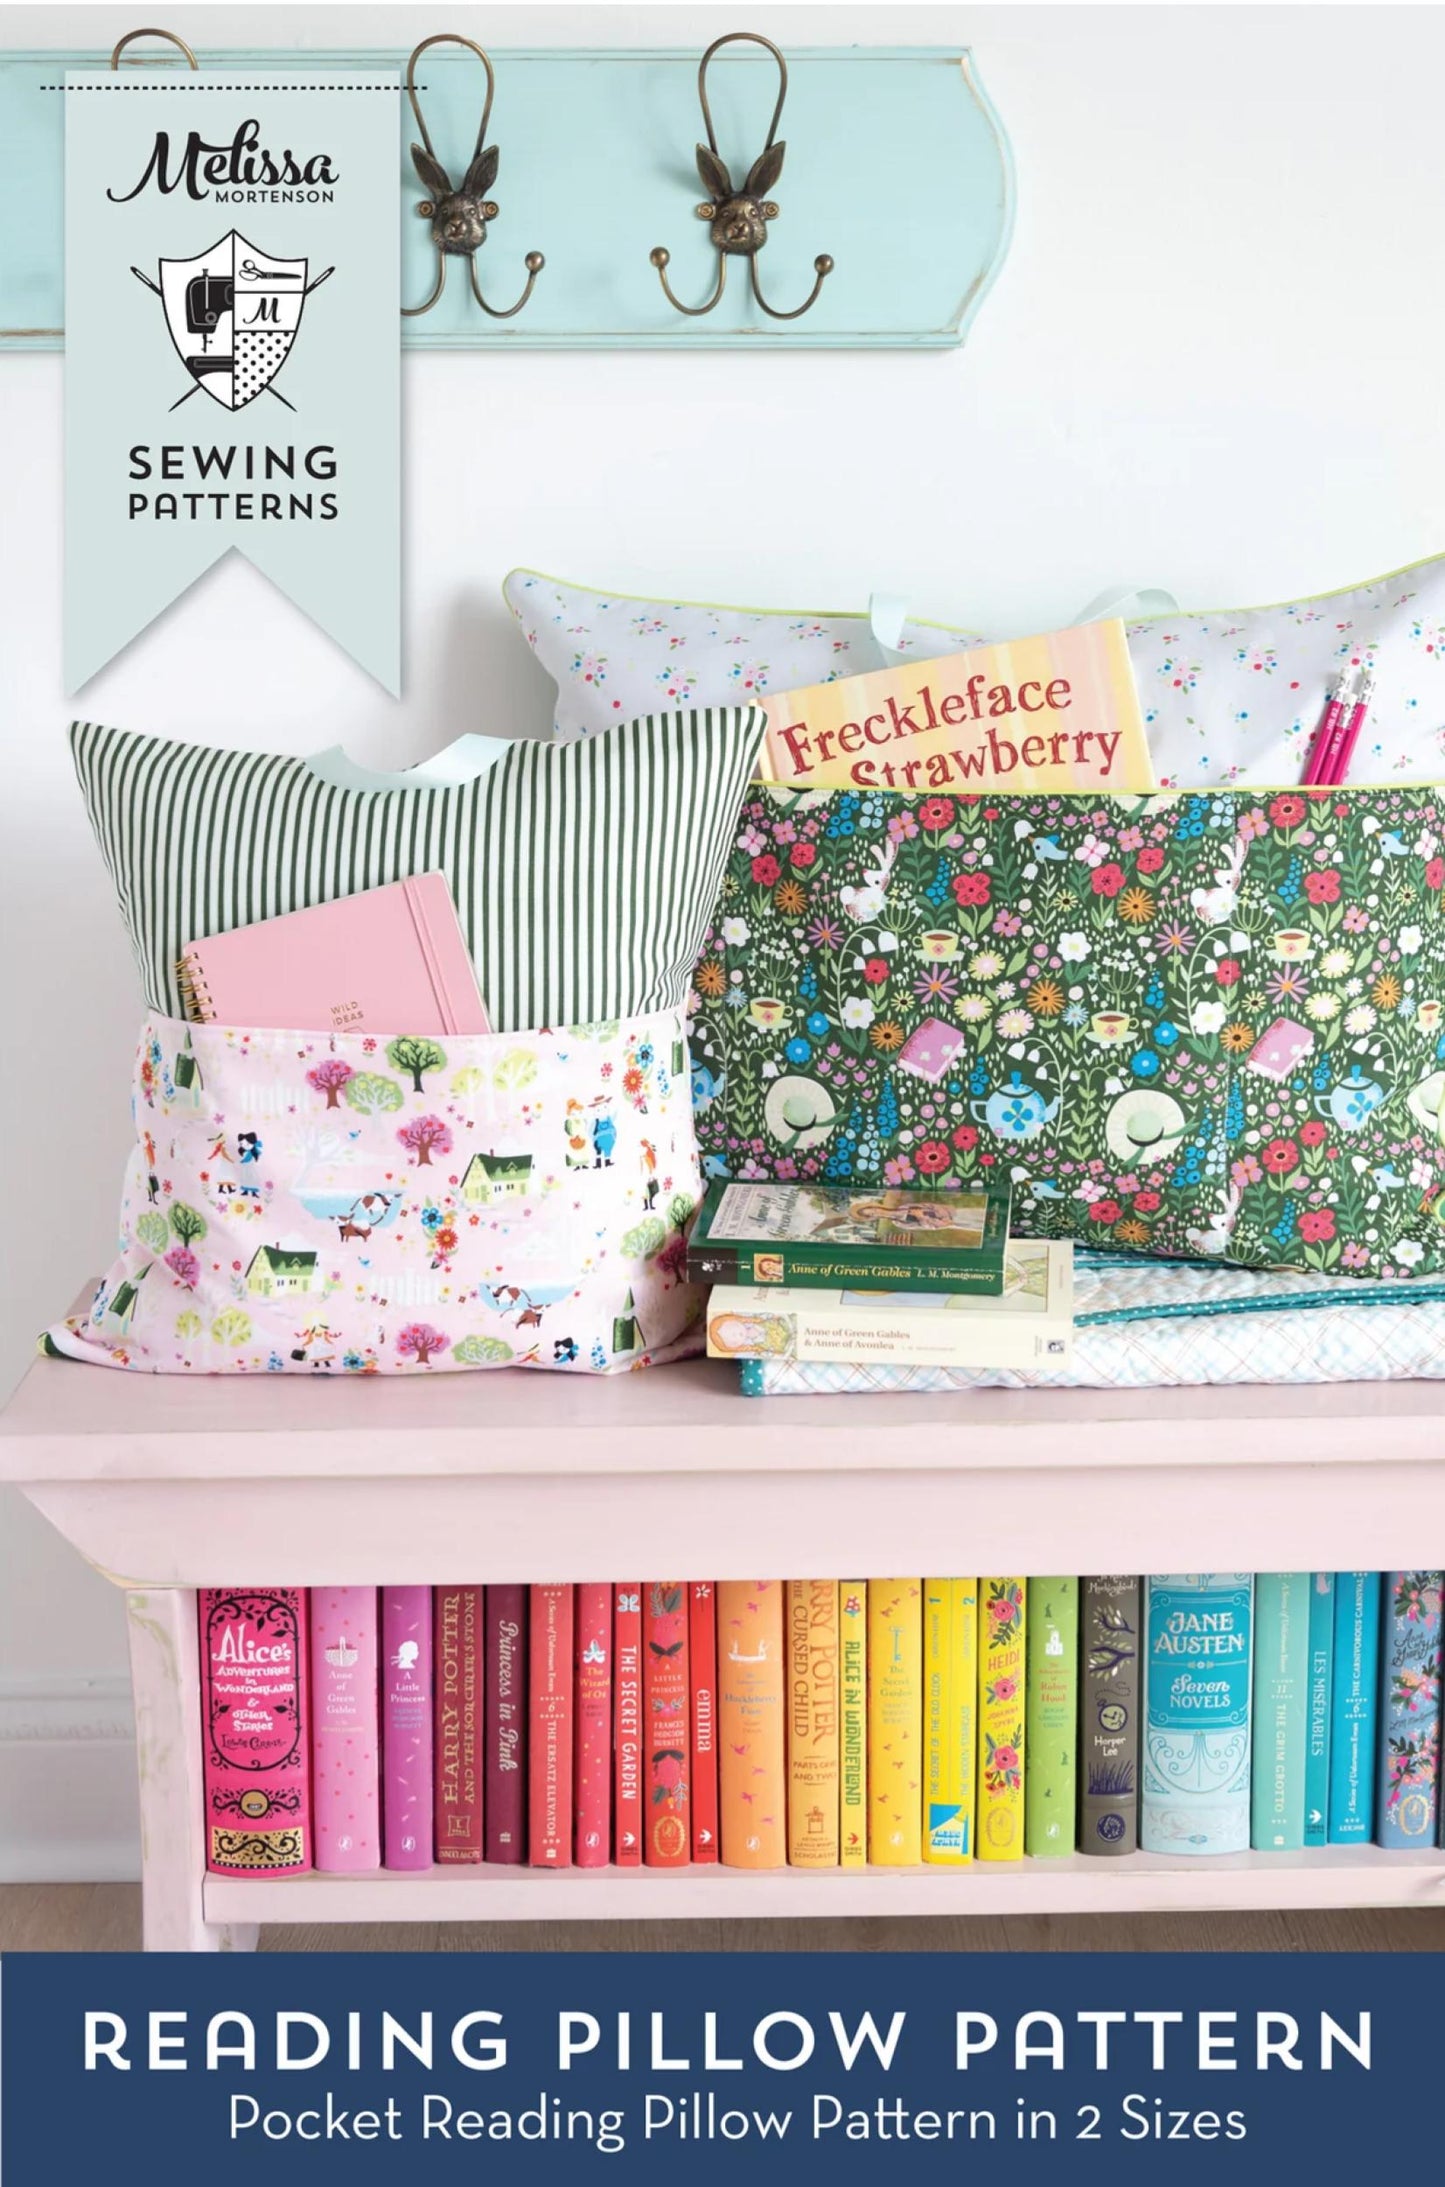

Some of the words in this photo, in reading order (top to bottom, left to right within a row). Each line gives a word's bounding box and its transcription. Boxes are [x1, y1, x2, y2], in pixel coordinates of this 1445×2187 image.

[777, 674, 1072, 776] Freckleface
[850, 728, 1123, 787] Strawberry
[330, 1001, 358, 1015] WILD
[332, 1011, 364, 1026] IDEAS
[788, 1263, 818, 1274] Anne
[820, 1263, 832, 1276] of
[834, 1264, 869, 1276] Green
[871, 1266, 912, 1278] Gables
[917, 1269, 926, 1278] L.
[928, 1269, 939, 1279] M.
[941, 1270, 996, 1282] Montgomery
[804, 1327, 830, 1337] Anne
[832, 1328, 843, 1337] of
[844, 1329, 875, 1338] Green
[876, 1329, 911, 1339] Gables
[804, 1339, 812, 1347] &
[814, 1339, 840, 1348] Anne
[842, 1340, 852, 1348] of
[854, 1340, 895, 1350] Avonlea
[810, 1580, 835, 1634] RRY
[963, 1597, 975, 1605] 2
[1355, 1577, 1364, 1618] CARNIVAL
[464, 1592, 475, 1643] STONE
[1168, 1611, 1234, 1634] JANE
[211, 1622, 292, 1664] Alice's
[442, 1593, 459, 1695] POTTER
[792, 1605, 808, 1675] CURSED
[1154, 1632, 1245, 1655] AUSTEN
[1353, 1619, 1362, 1679] CARNIVOROUS
[499, 1619, 519, 1698] Princess
[621, 1645, 637, 1673] THE
[987, 1649, 1019, 1671] HEIDI
[1313, 1651, 1327, 1674] LES
[329, 1671, 353, 1680] Anne
[404, 1671, 411, 1680] A
[586, 1667, 603, 1676] The
[336, 1681, 346, 1691] of
[396, 1682, 420, 1692] Little
[464, 1645, 475, 1732] SORCERER'S
[582, 1690, 591, 1699] of
[810, 1643, 836, 1746] POTTER
[1171, 1673, 1230, 1694] Seven
[1352, 1680, 1360, 1697] THE
[247, 1697, 259, 1708] &
[326, 1705, 356, 1714] Gables
[327, 1693, 355, 1703] Green
[390, 1694, 426, 1703] Princess
[621, 1681, 637, 1736] SECRET
[794, 1680, 809, 1737] CHILD
[1170, 1694, 1231, 1708] NOVELS
[499, 1702, 516, 1721] in
[696, 1688, 711, 1753] emma
[1276, 1704, 1286, 1727] THE
[547, 1720, 556, 1740] THE
[931, 1719, 940, 1732] THE
[442, 1701, 459, 1804] HARRY
[464, 1733, 475, 1766] THE
[499, 1727, 519, 1772] Pink
[1094, 1735, 1127, 1748] Harper
[1103, 1746, 1118, 1756] Lee
[1276, 1730, 1286, 1761] GRIM
[547, 1744, 556, 1782] ERSATZ
[621, 1742, 637, 1799] GARDEN
[464, 1768, 475, 1805] AND
[793, 1773, 813, 1781] AND
[1274, 1764, 1285, 1813] GROTTO
[930, 1783, 939, 1795] THE
[546, 1785, 556, 1837] ELEVATOR
